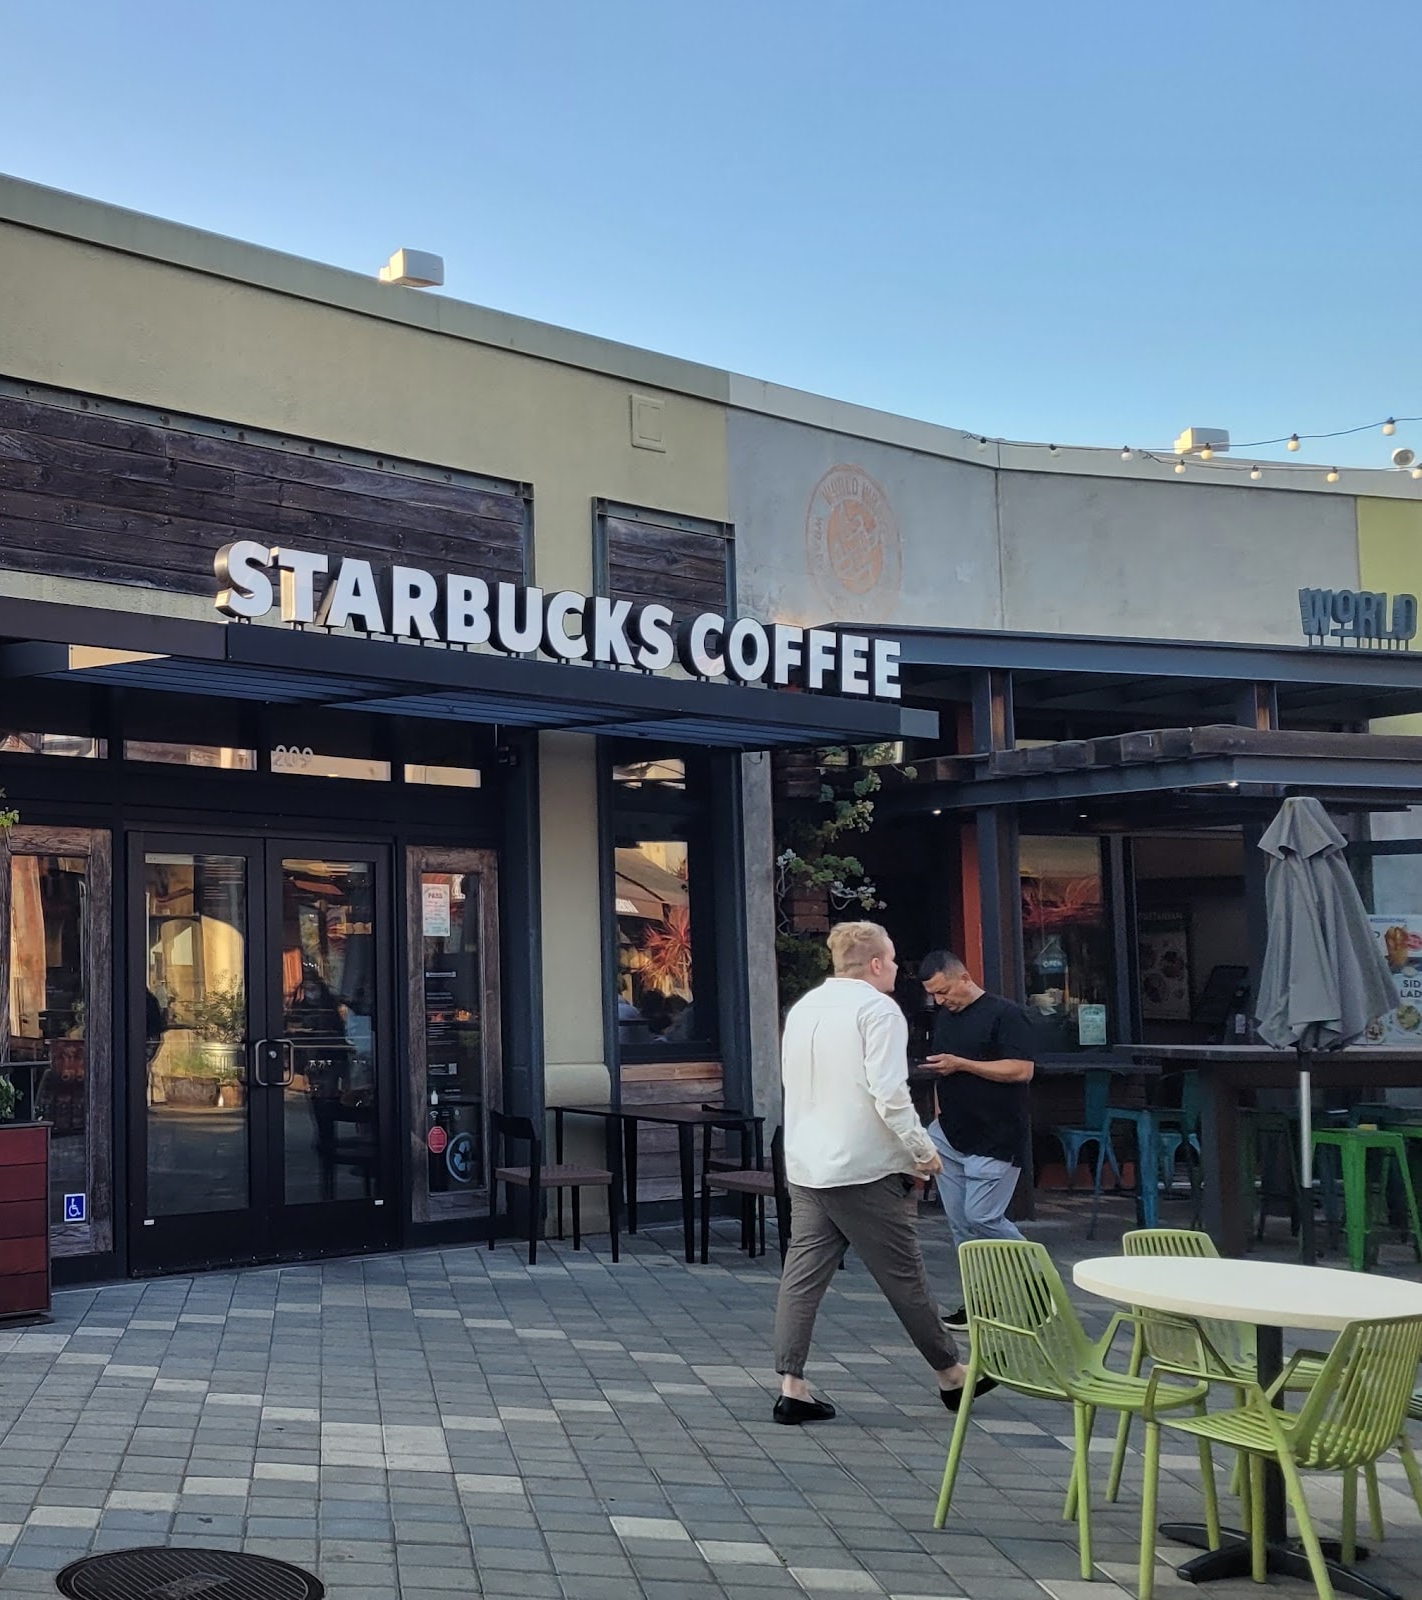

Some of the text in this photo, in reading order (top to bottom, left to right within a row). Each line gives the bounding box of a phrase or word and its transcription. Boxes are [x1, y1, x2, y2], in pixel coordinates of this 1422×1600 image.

[215, 538, 903, 700] STARBUCKS COFFEE
[1298, 587, 1418, 640] WORLD
[273, 744, 314, 768] 209
[1042, 960, 1062, 969] OPEN
